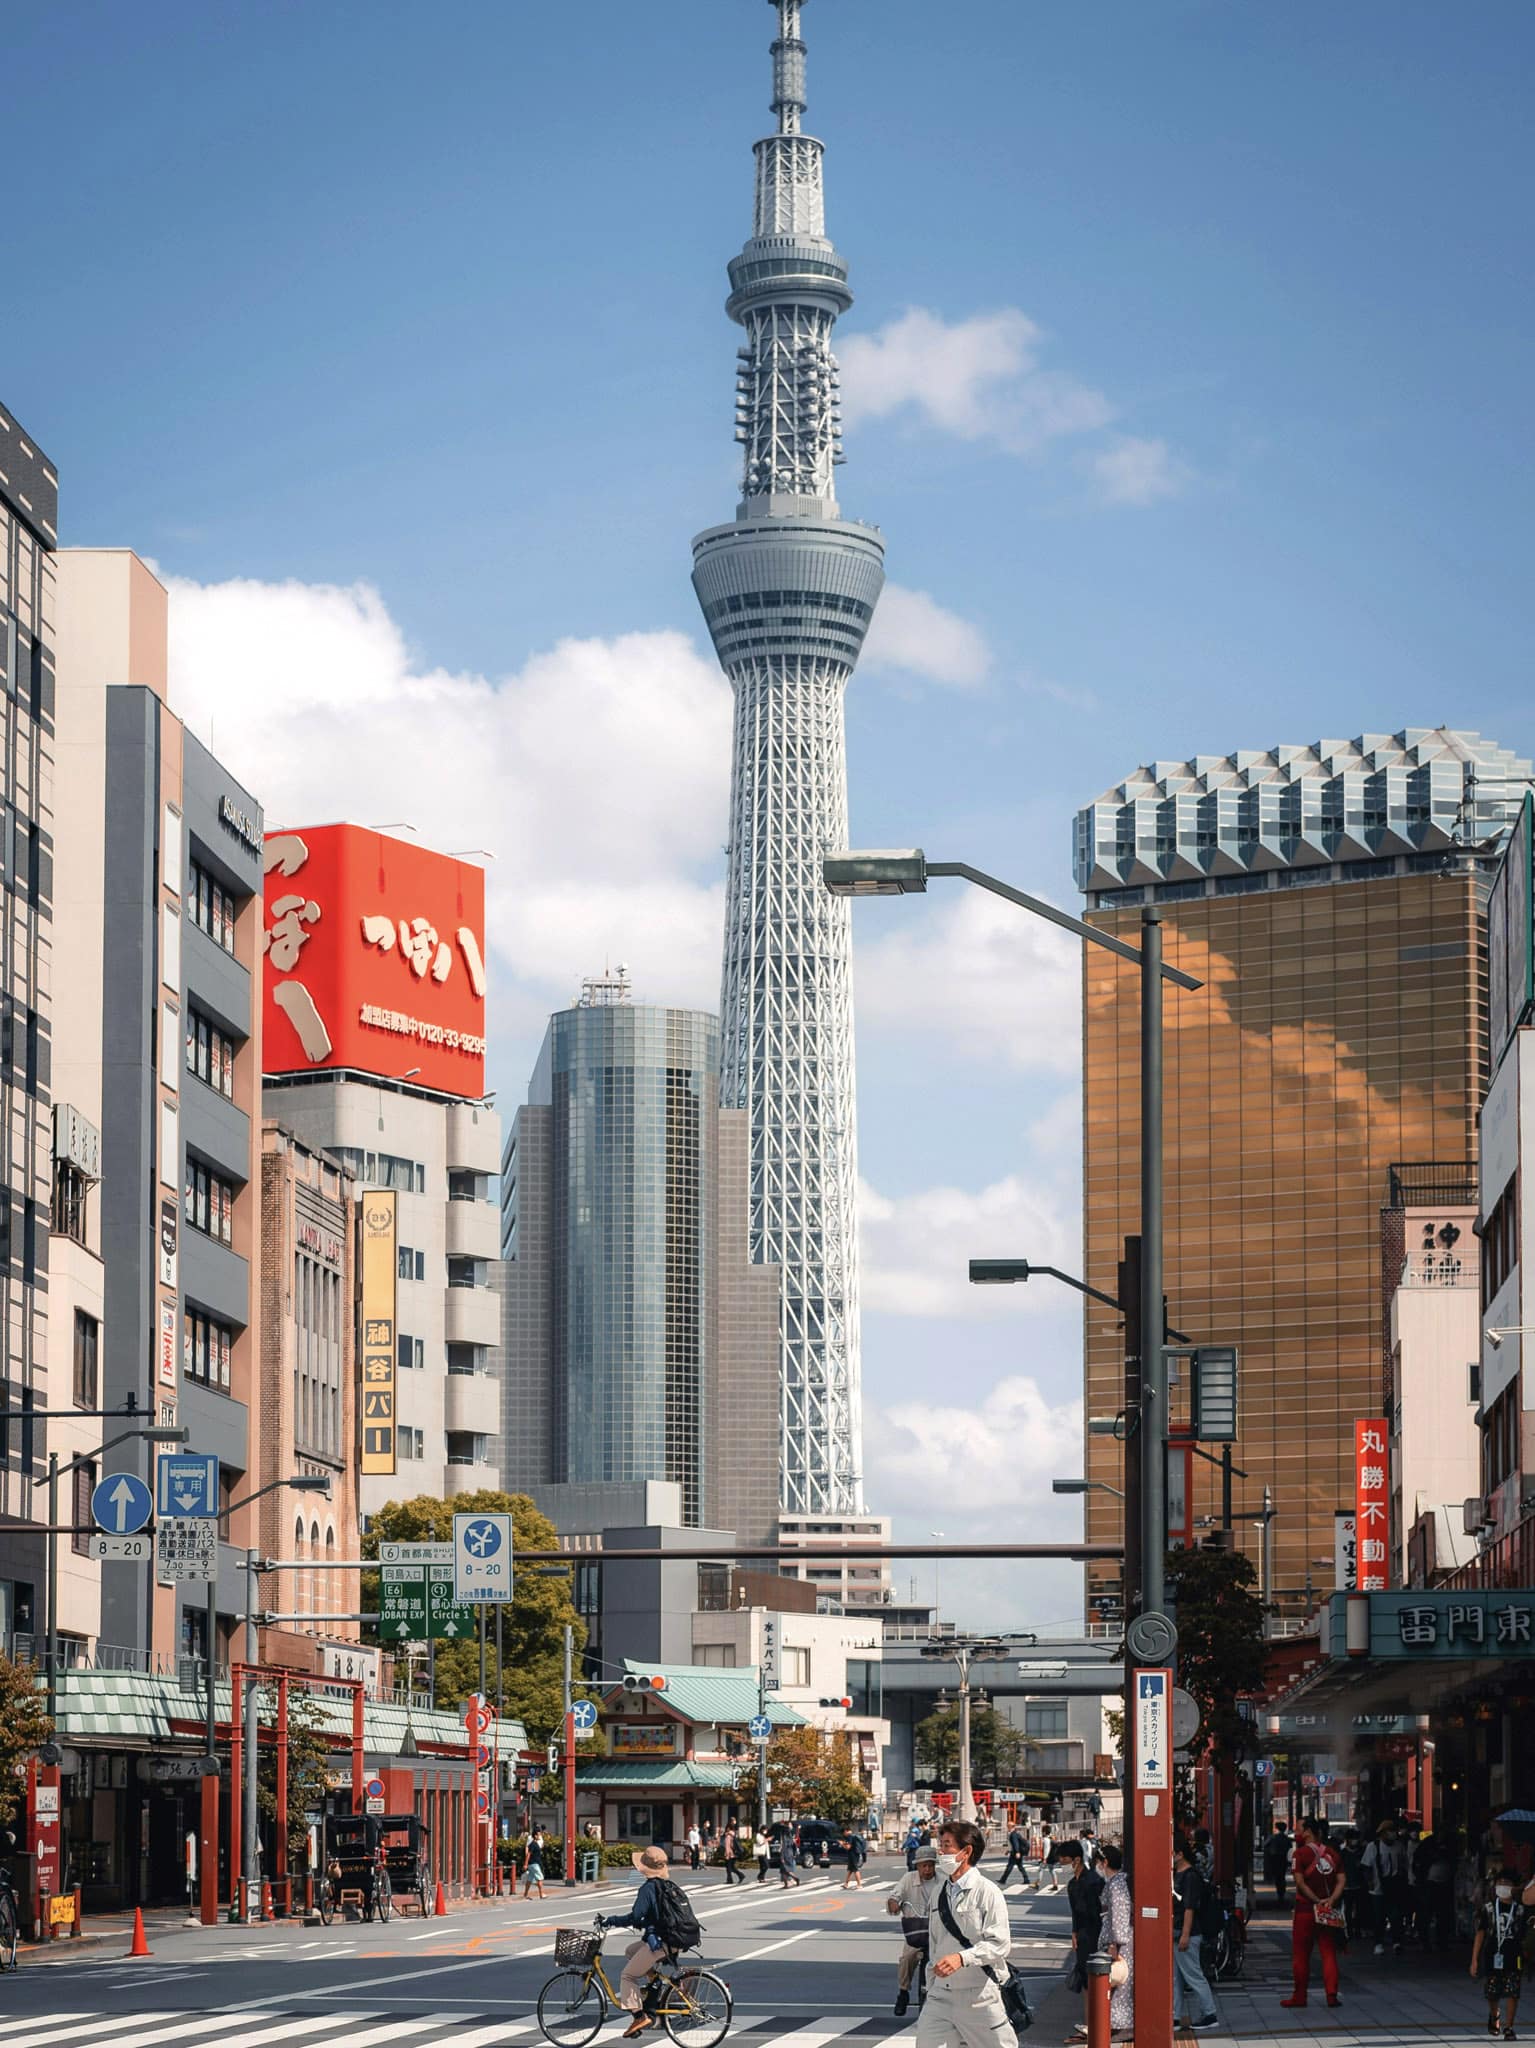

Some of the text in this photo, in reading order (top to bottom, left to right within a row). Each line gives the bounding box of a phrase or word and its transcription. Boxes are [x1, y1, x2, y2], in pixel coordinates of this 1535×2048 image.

[366, 1322, 391, 1453] 神谷バー
[1360, 1429, 1385, 1590] 丸勝不動産
[387, 1548, 394, 1558] 6
[401, 1549, 432, 1559] 首都高
[162, 1571, 210, 1580] ここまで
[385, 1569, 421, 1580] 向島入口
[387, 1585, 400, 1595] E6
[384, 1599, 422, 1610] 常磐道
[381, 1611, 424, 1620] JOBAN EXP
[432, 1610, 470, 1619] Circle 1
[1399, 1604, 1531, 1643] 雷門東
[763, 1621, 774, 1672] 水上バス
[1256, 1762, 1264, 1773] 6
[1319, 1775, 1326, 1784] 6
